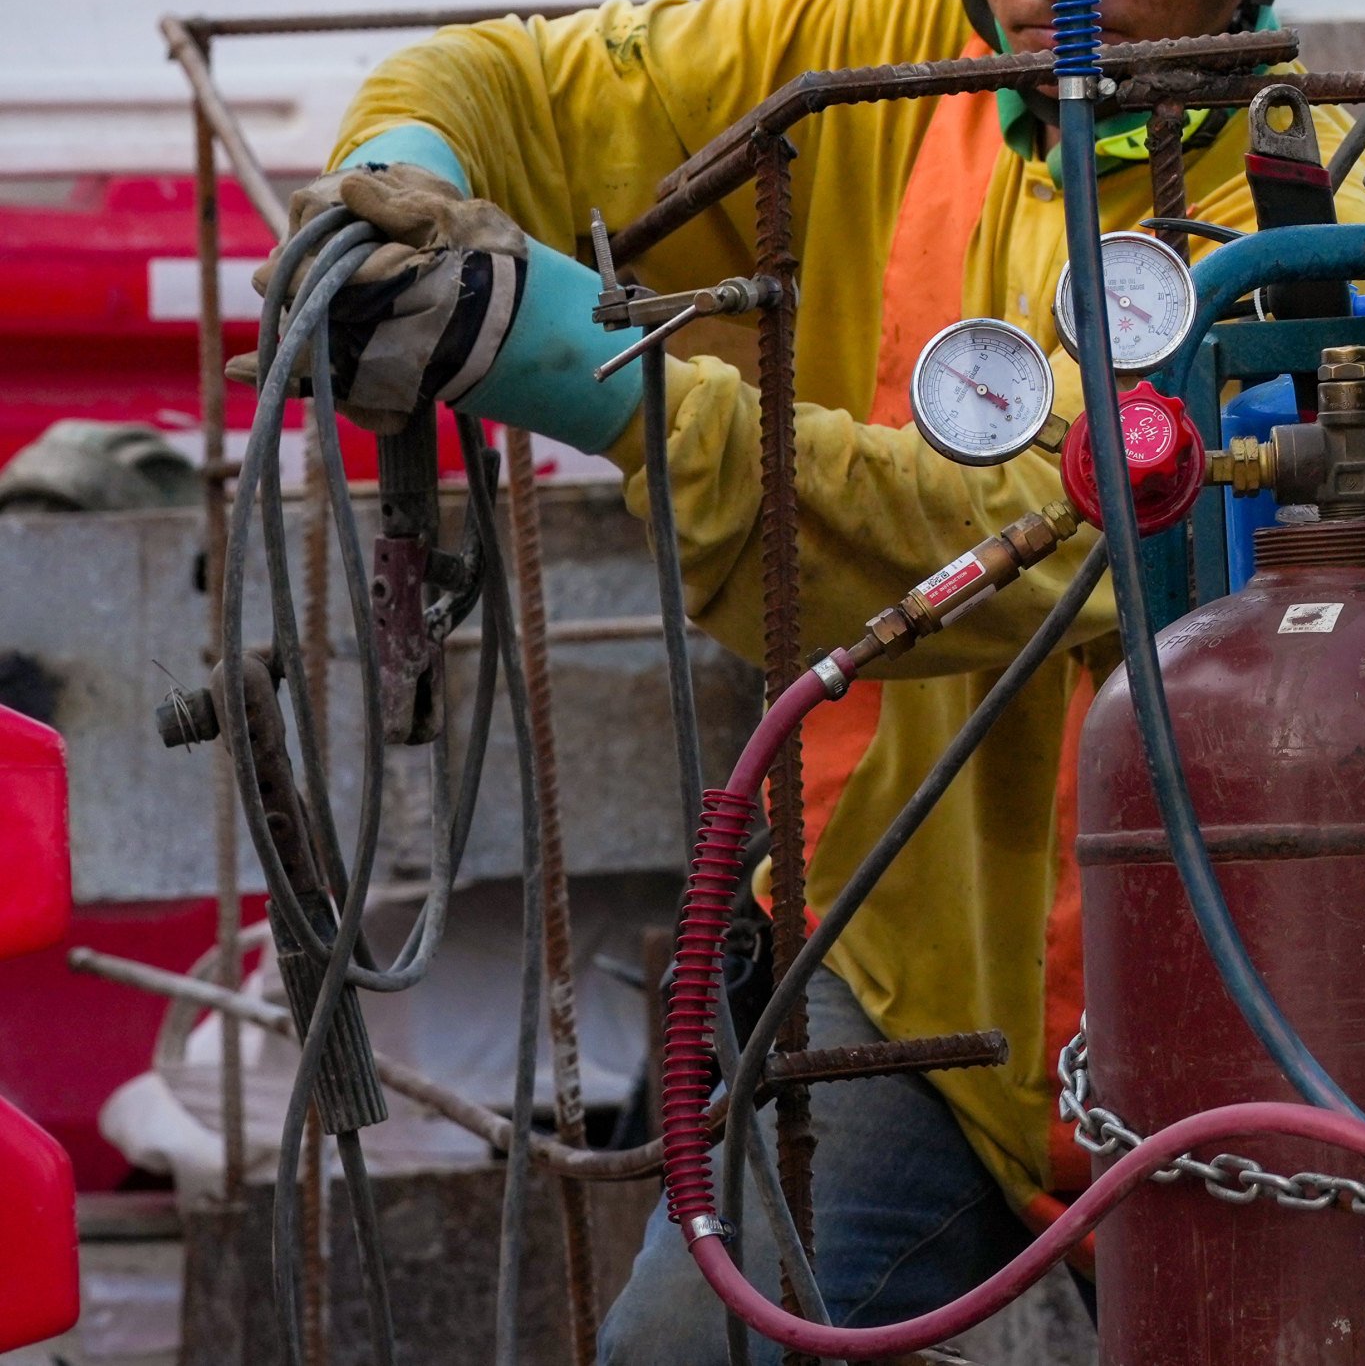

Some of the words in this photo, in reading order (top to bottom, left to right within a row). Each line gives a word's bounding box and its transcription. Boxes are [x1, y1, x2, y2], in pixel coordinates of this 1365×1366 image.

[1152, 410, 1164, 421] LO
[1162, 427, 1169, 436] HI
[1124, 448, 1144, 460] APAN
[940, 571, 967, 592] INSTRUCTION
